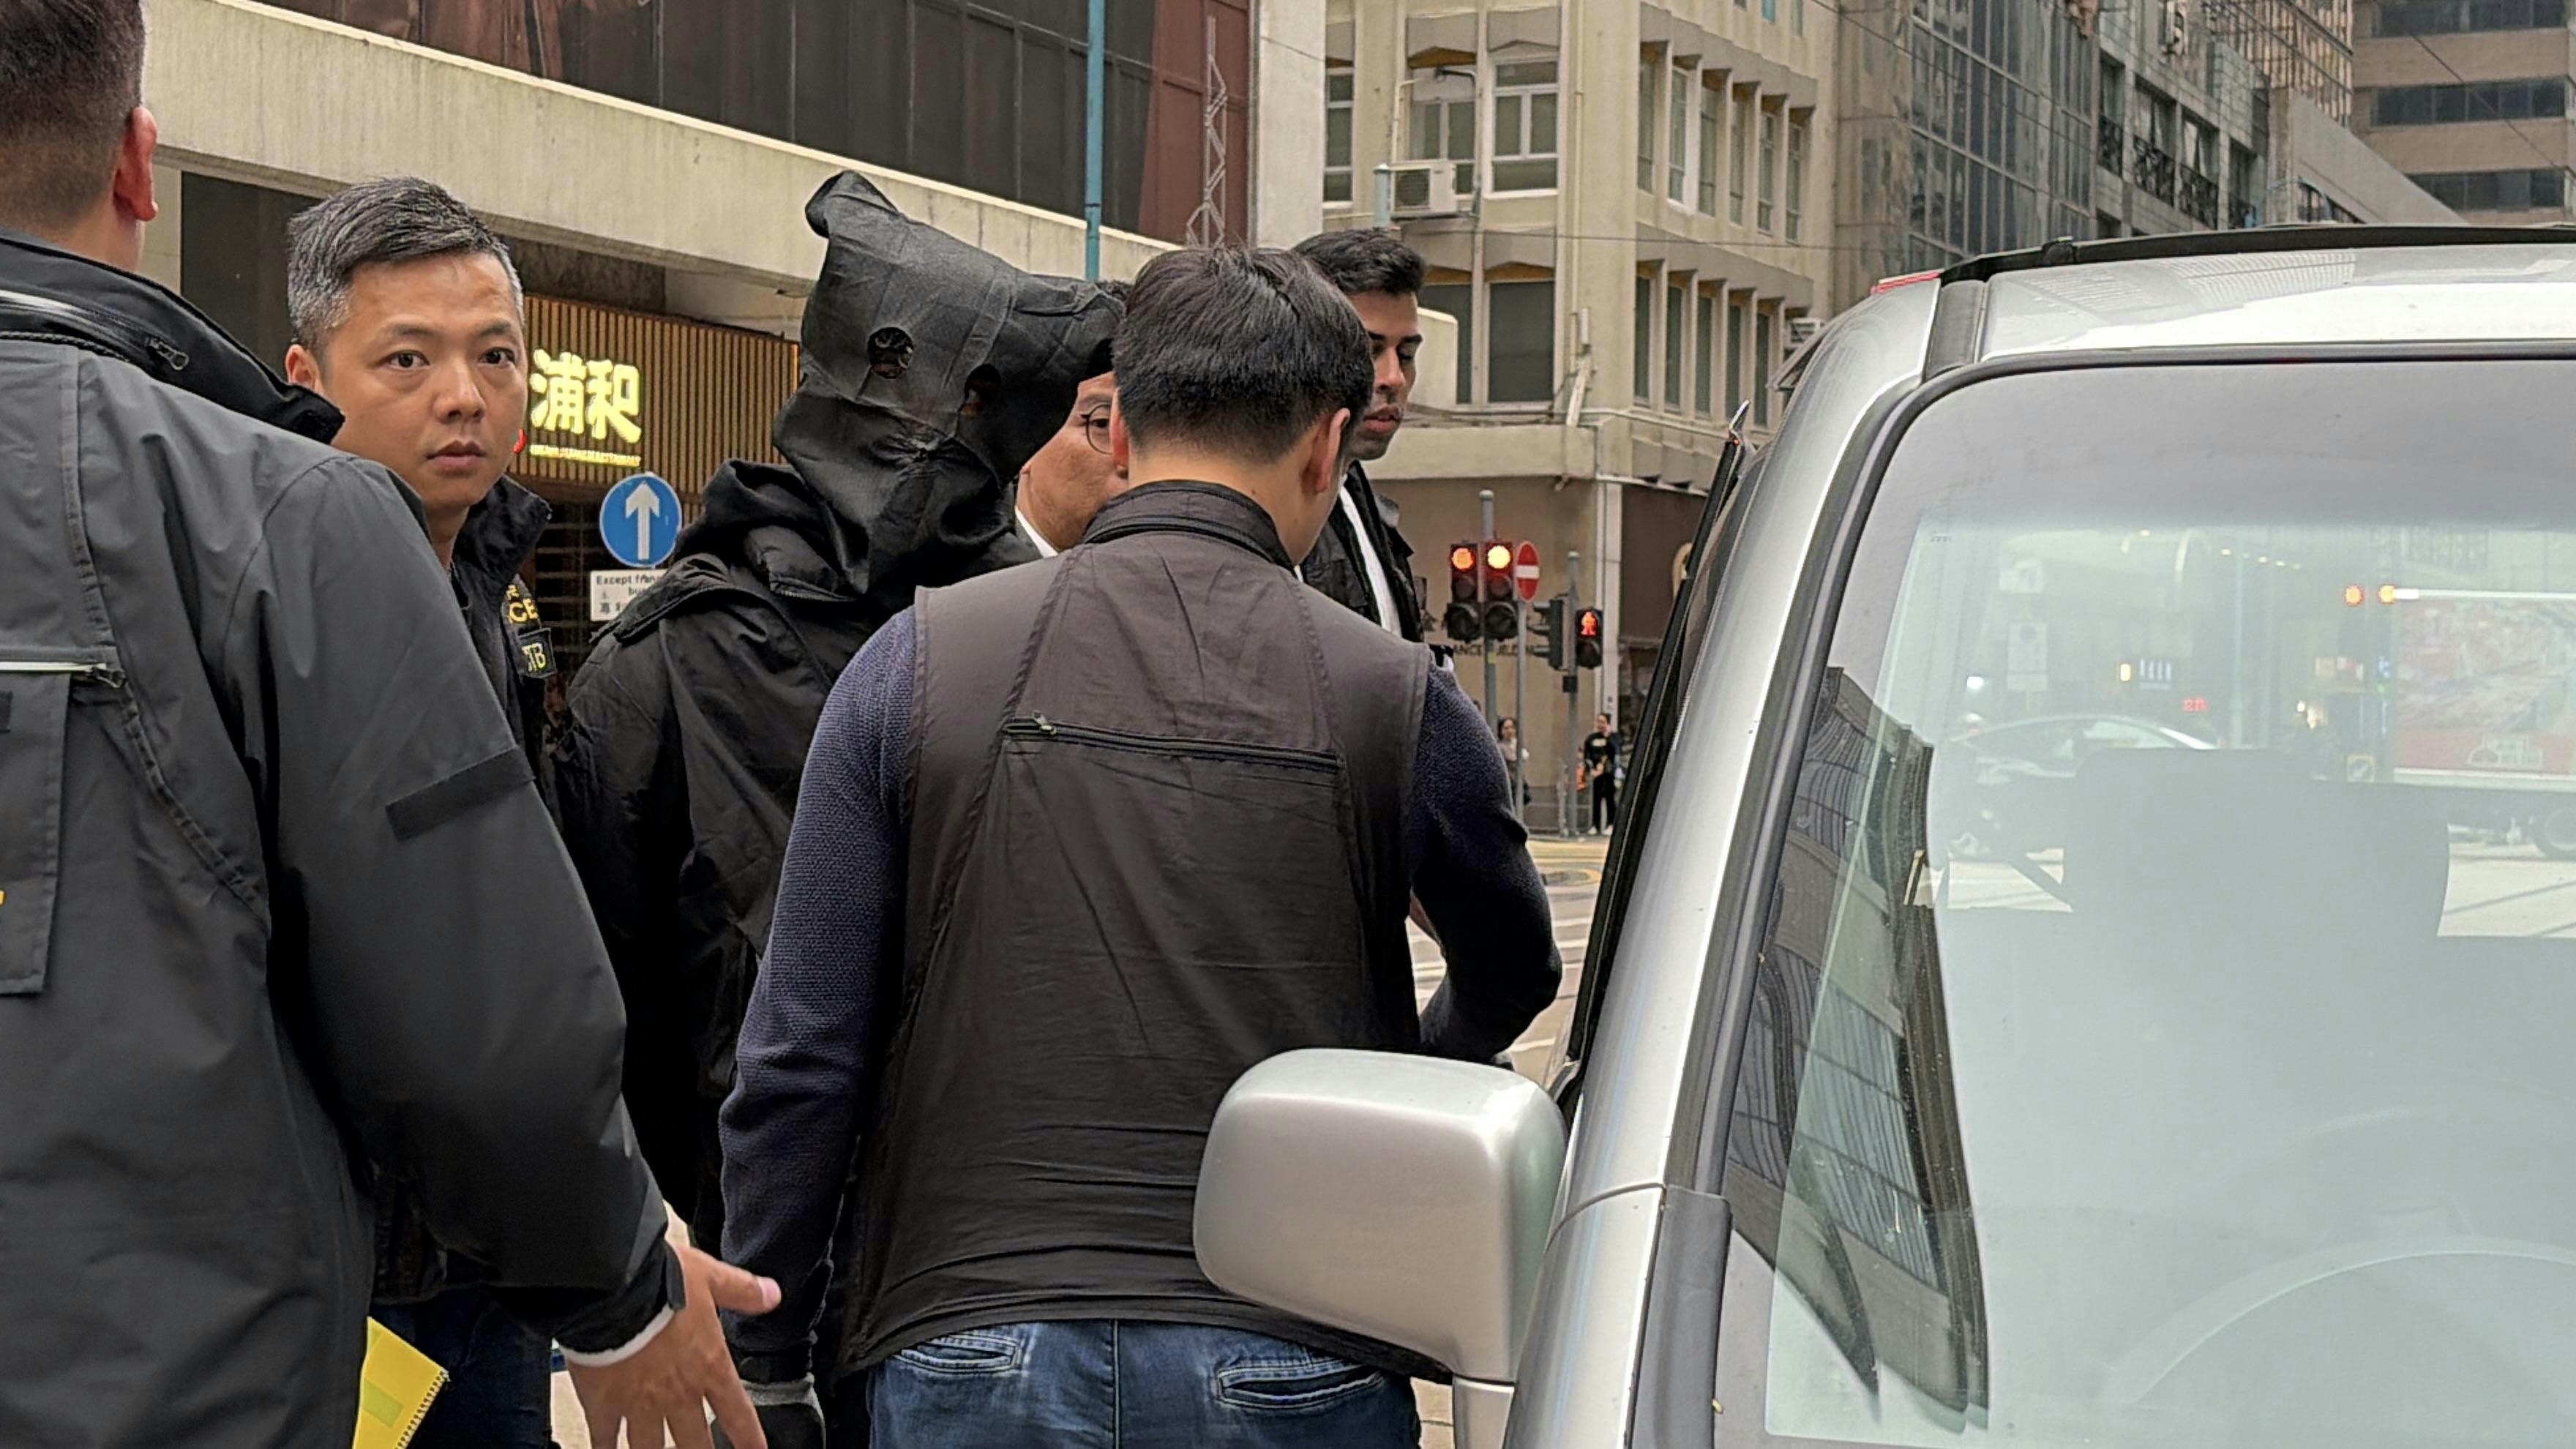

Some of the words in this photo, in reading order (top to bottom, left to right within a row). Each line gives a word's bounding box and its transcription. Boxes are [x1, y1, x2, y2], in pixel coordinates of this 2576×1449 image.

[530, 349, 641, 444] 浦和
[596, 574, 632, 585] Except
[508, 599, 539, 624] CE
[1453, 644, 1483, 656] ANCE
